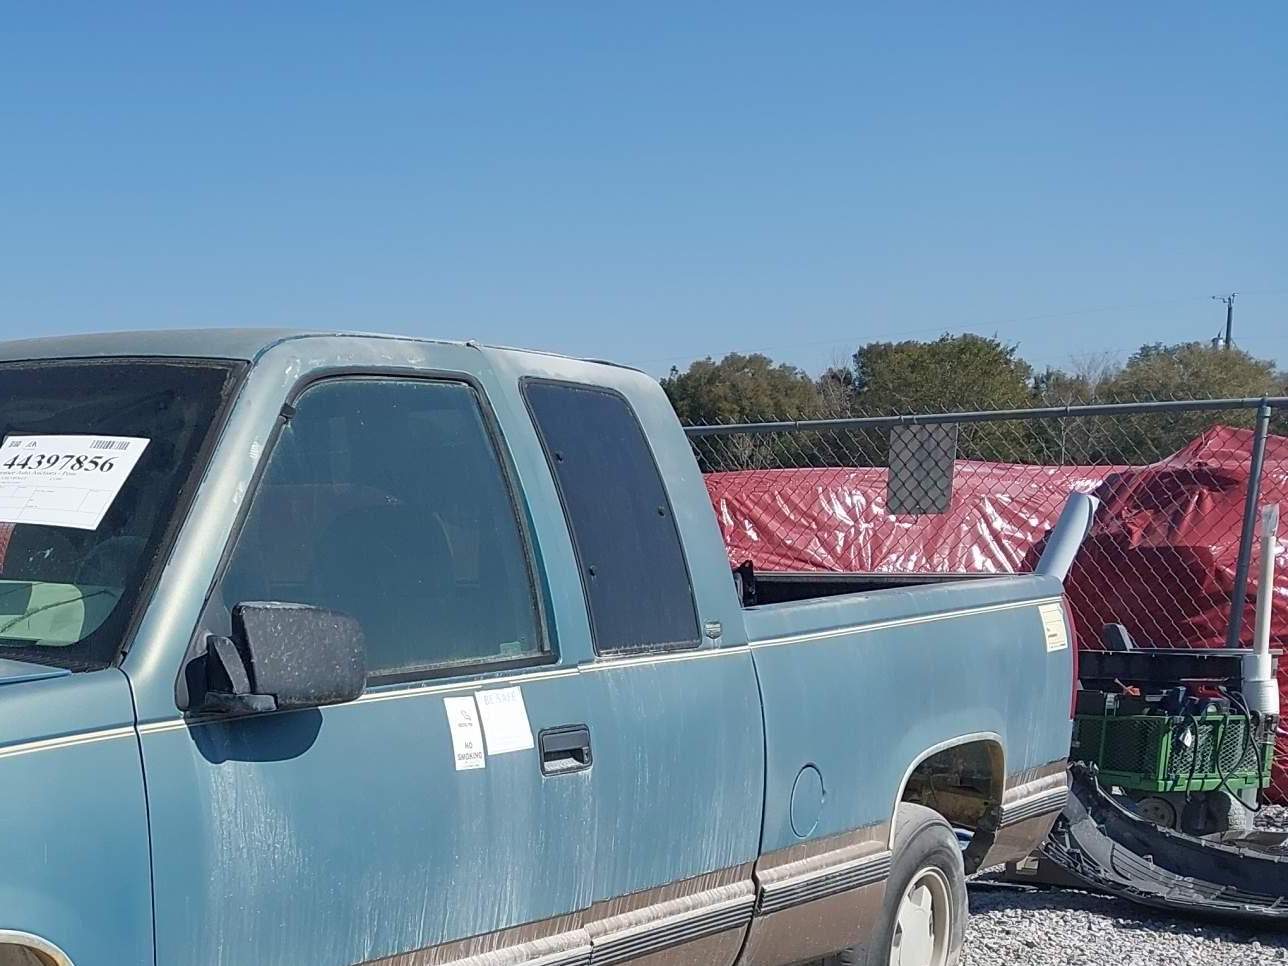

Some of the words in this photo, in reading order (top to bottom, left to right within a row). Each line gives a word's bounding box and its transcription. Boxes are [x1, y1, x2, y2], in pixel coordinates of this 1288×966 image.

[3, 453, 120, 473] 44397856
[464, 741, 473, 749] NO
[457, 751, 483, 761] SMOKING
